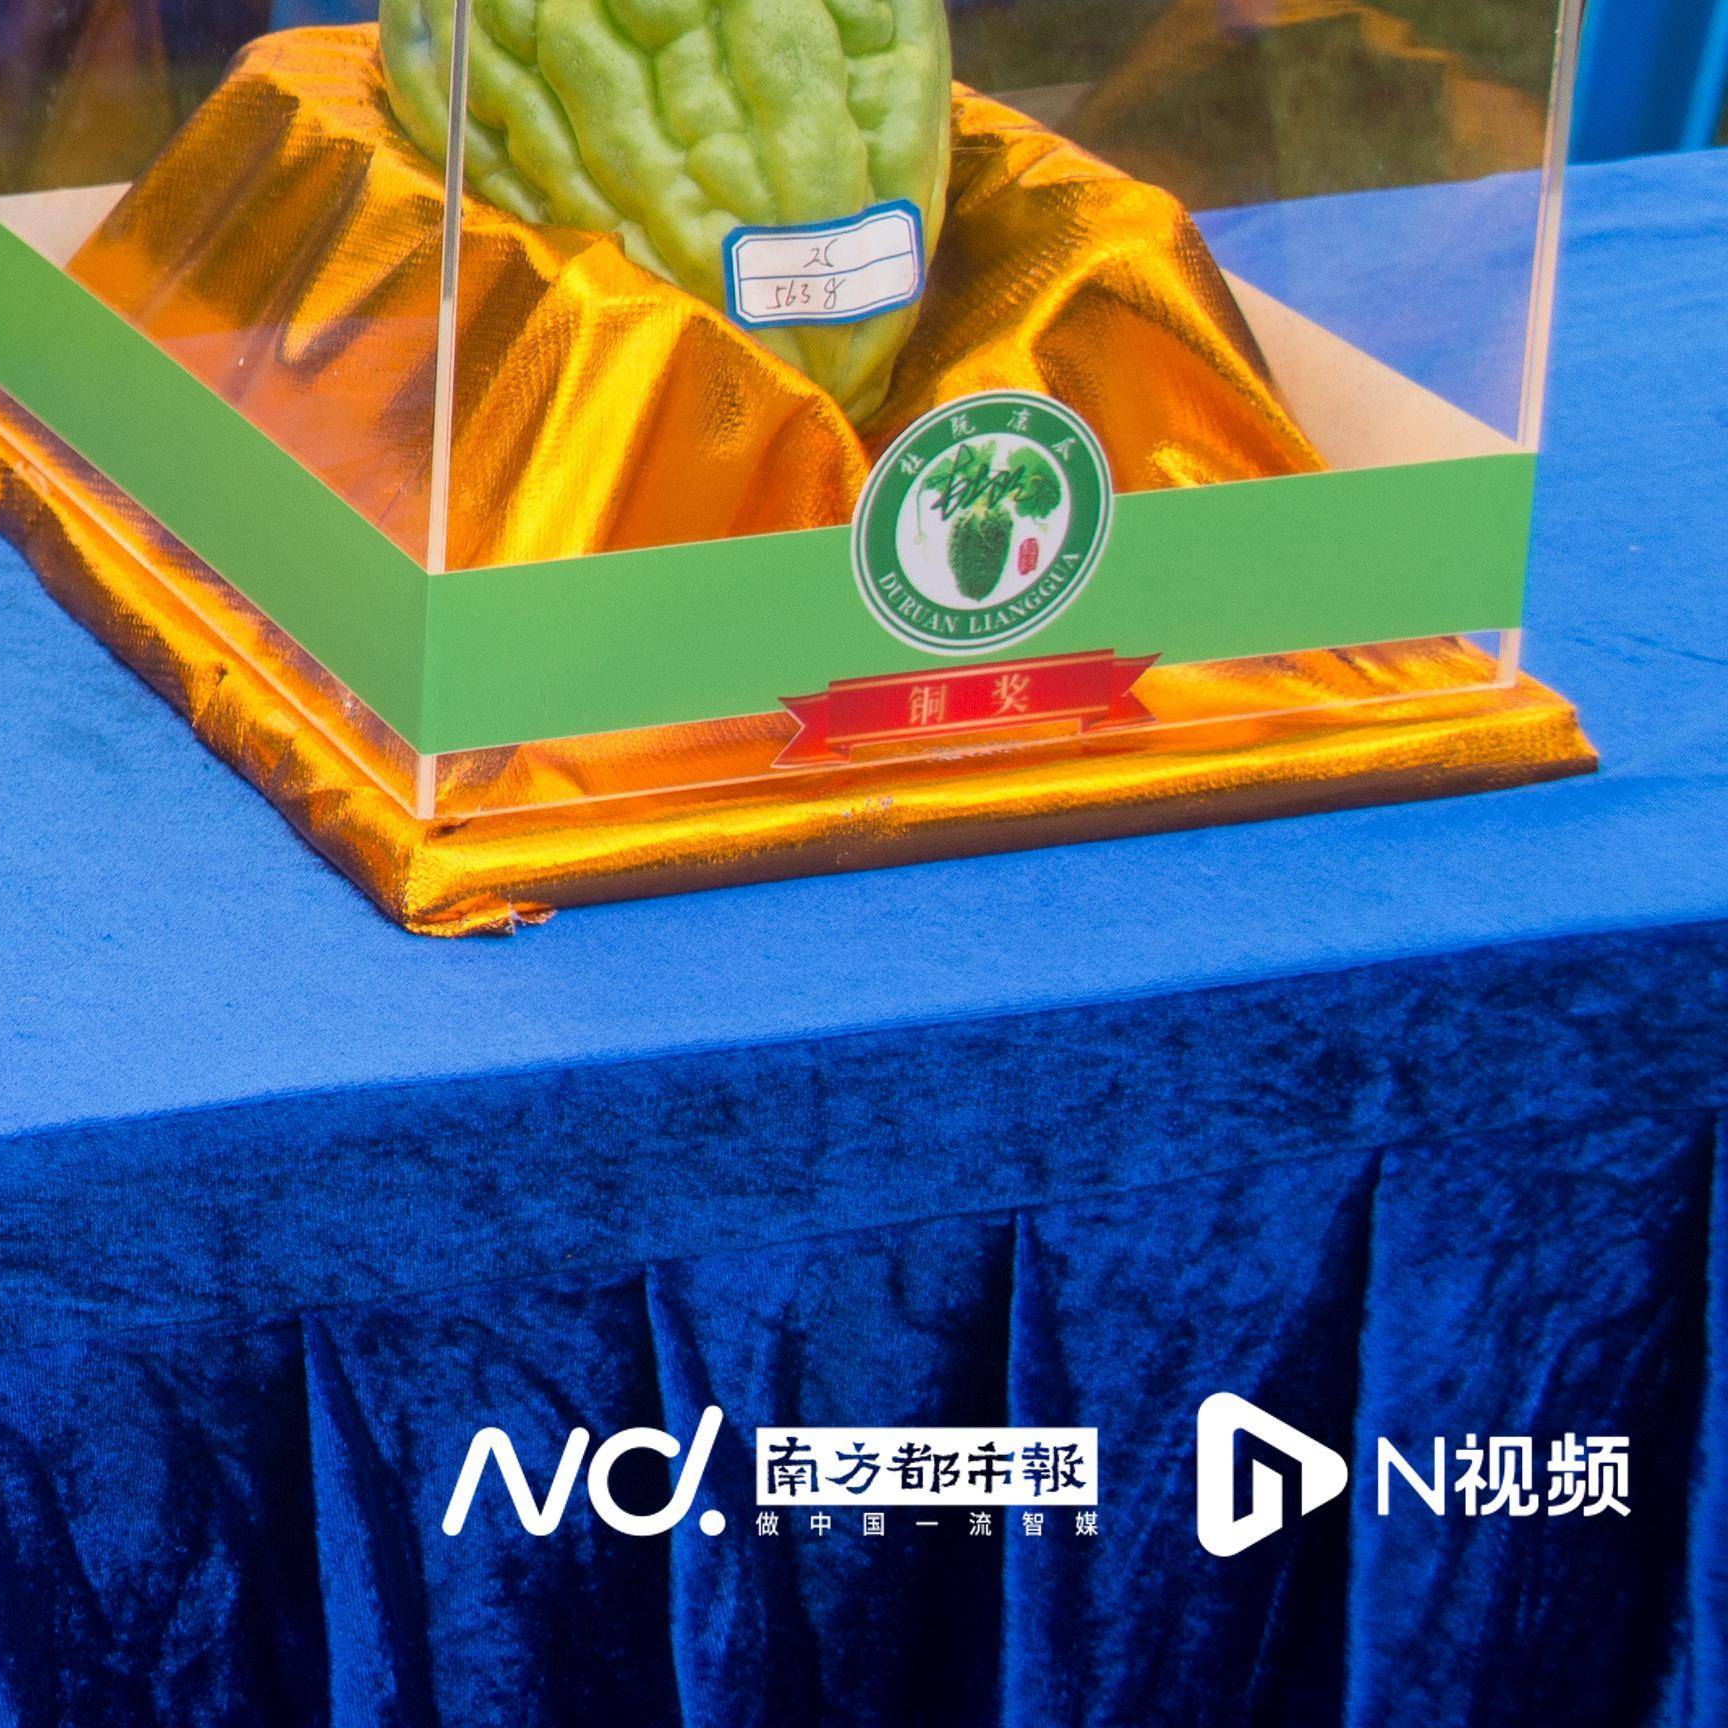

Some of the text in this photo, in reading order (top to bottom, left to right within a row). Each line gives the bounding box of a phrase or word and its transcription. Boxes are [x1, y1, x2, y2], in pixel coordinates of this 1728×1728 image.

[878, 571, 959, 633] DURUAN
[968, 552, 1080, 634] LIANGGUA
[908, 673, 1031, 725] 铜奖
